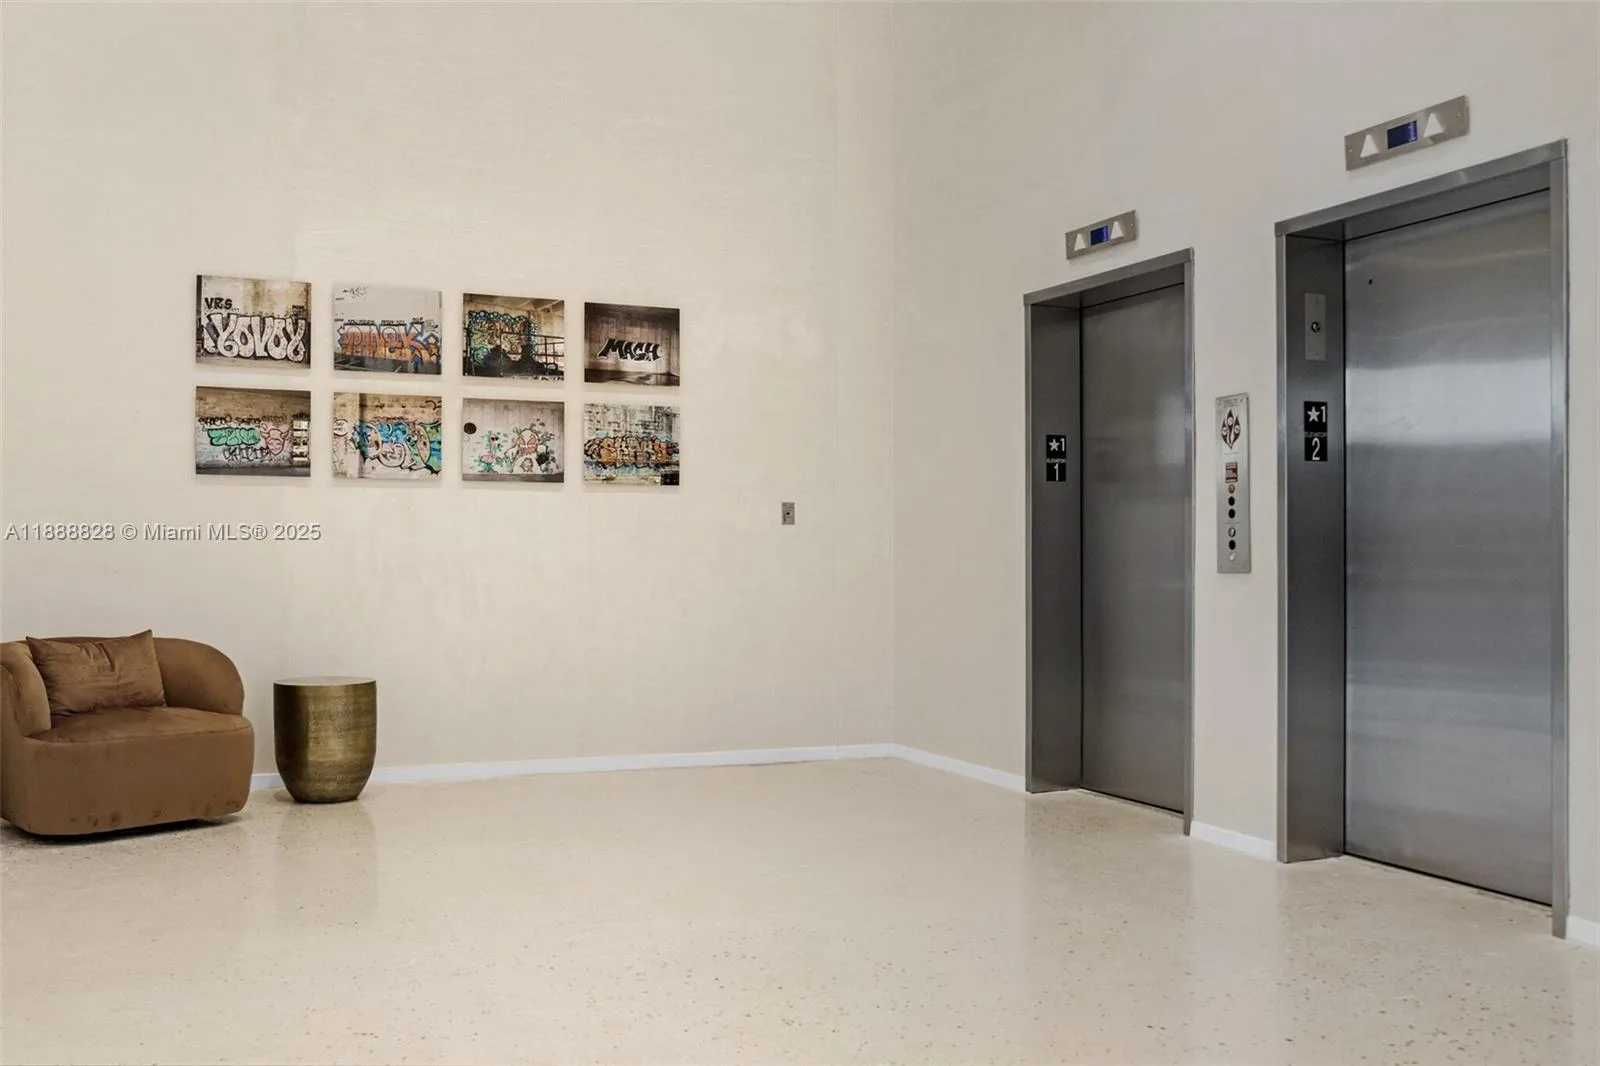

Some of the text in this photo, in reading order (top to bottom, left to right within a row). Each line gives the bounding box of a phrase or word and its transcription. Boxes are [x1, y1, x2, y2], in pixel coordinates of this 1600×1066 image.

[1320, 405, 1326, 423] 1
[1060, 438, 1065, 451] 1
[1312, 437, 1320, 461] 2
[1054, 463, 1059, 481] 1
